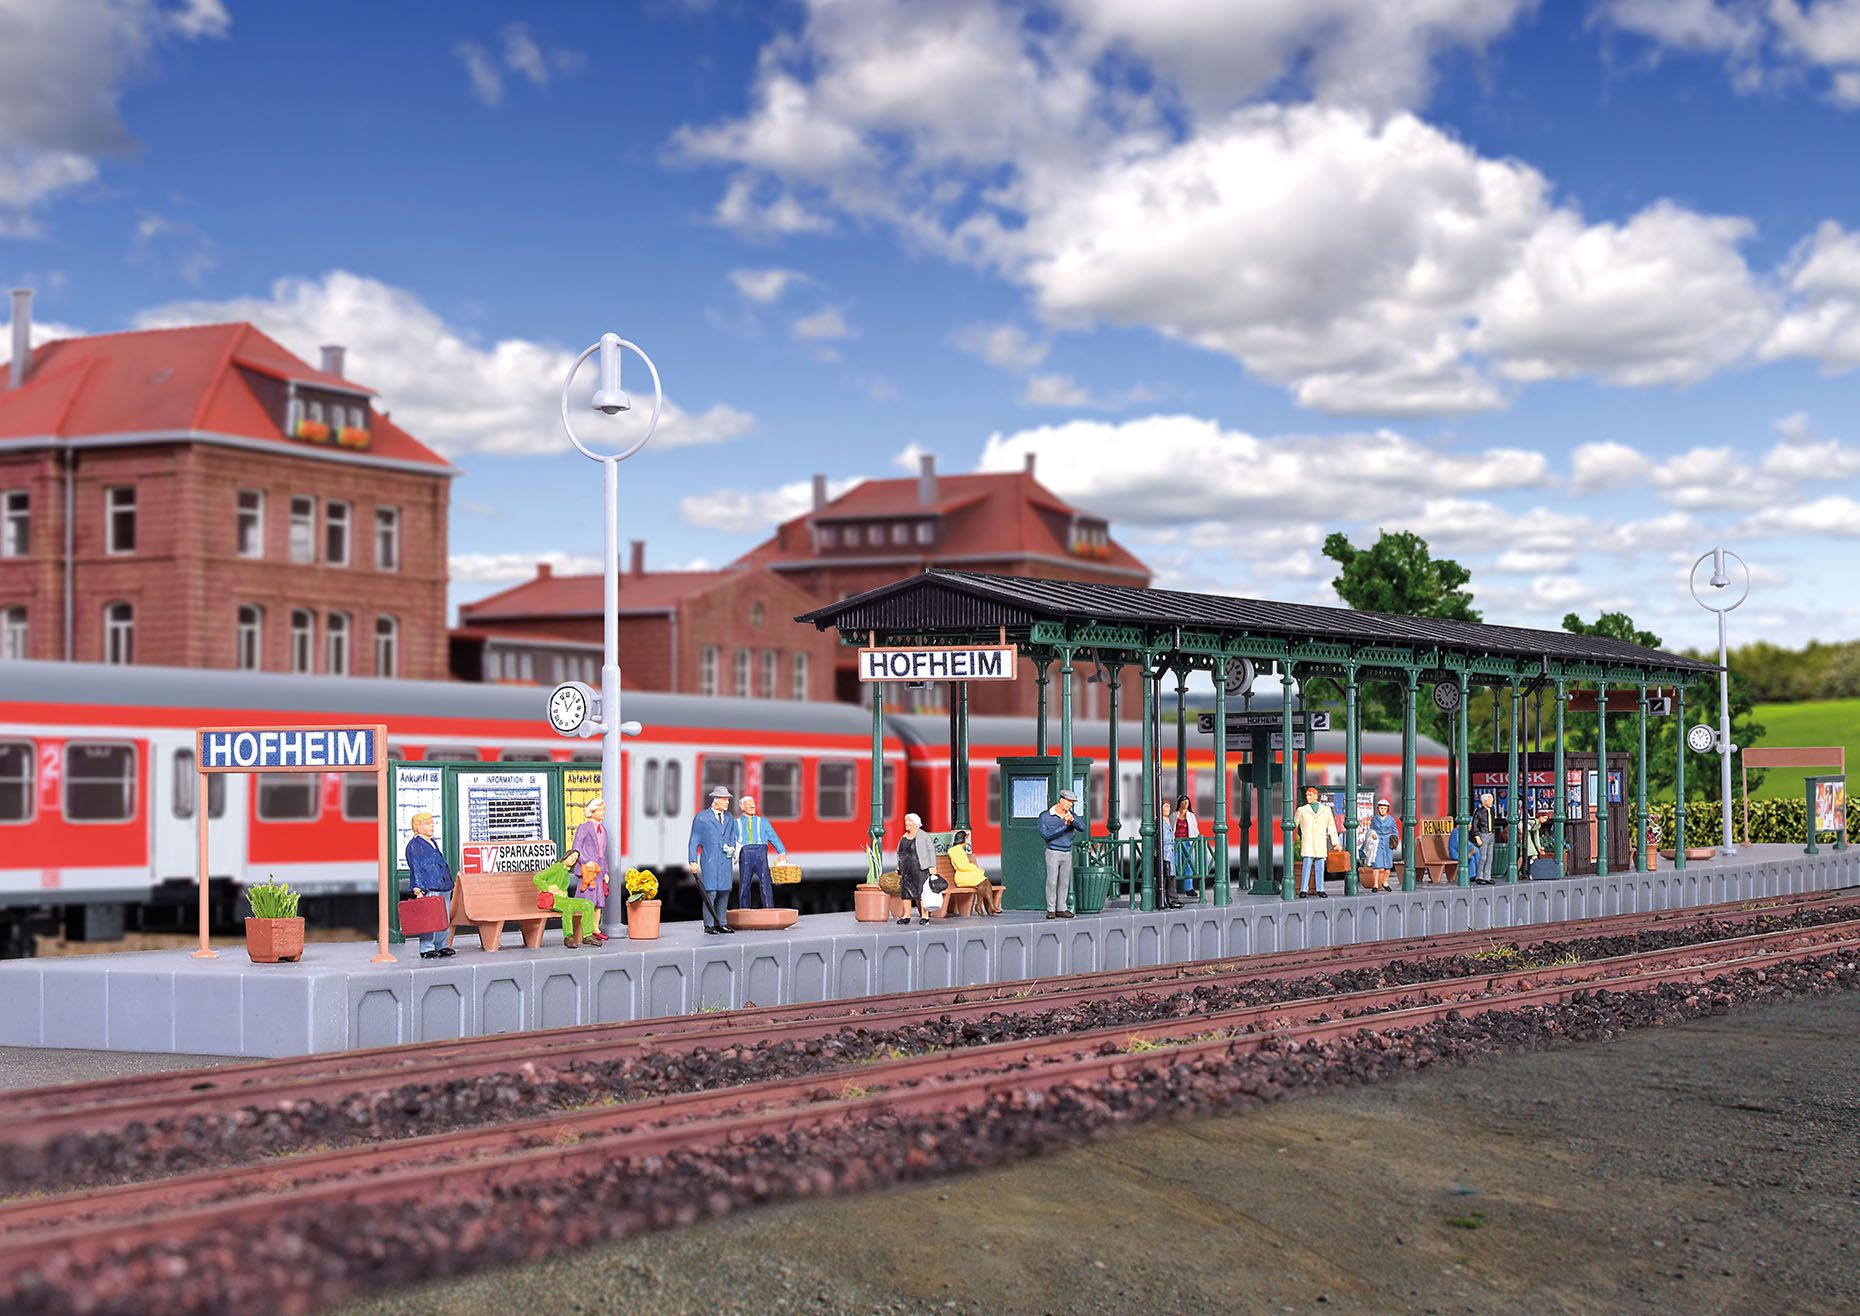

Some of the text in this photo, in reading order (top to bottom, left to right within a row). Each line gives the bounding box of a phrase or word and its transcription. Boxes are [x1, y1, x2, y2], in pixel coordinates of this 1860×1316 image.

[870, 651, 1001, 677] HOFHEIM
[1201, 715, 1213, 729] 3
[1313, 713, 1326, 728] 2
[210, 731, 366, 767] HOFHEIM
[485, 776, 524, 784] INFORMATION
[568, 773, 592, 784] Abfahrt
[1423, 820, 1452, 835] RENAULT
[499, 844, 556, 859] SPARKASSEN
